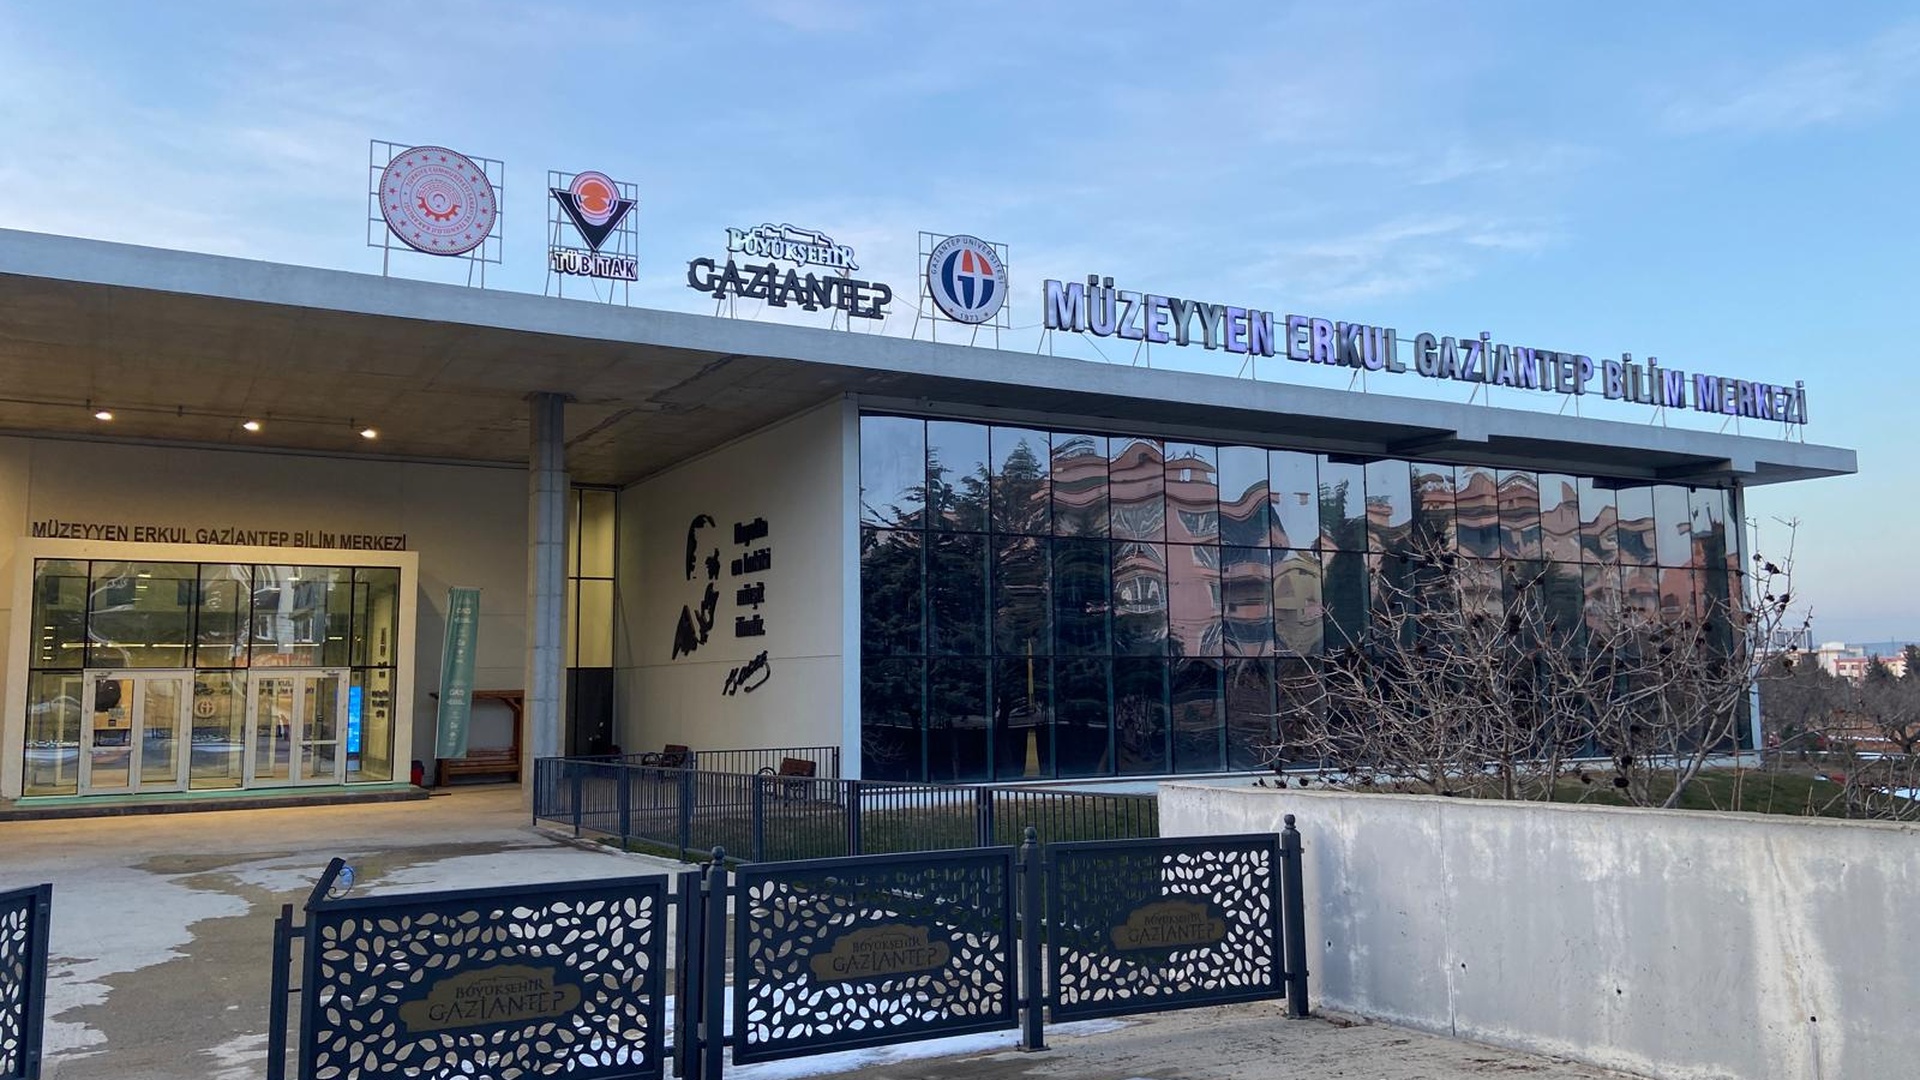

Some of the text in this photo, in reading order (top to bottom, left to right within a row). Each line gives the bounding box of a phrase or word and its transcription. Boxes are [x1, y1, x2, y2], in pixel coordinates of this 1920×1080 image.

[553, 249, 638, 281] TÜBİTAK
[1044, 274, 1809, 424] MÜZEYYEN ERKUL GAZİANTEP BİLİM MERKEZİ
[32, 519, 408, 552] MÜZEYYEN ERKUL GAZİANTEP BİLİM MERKEZİ
